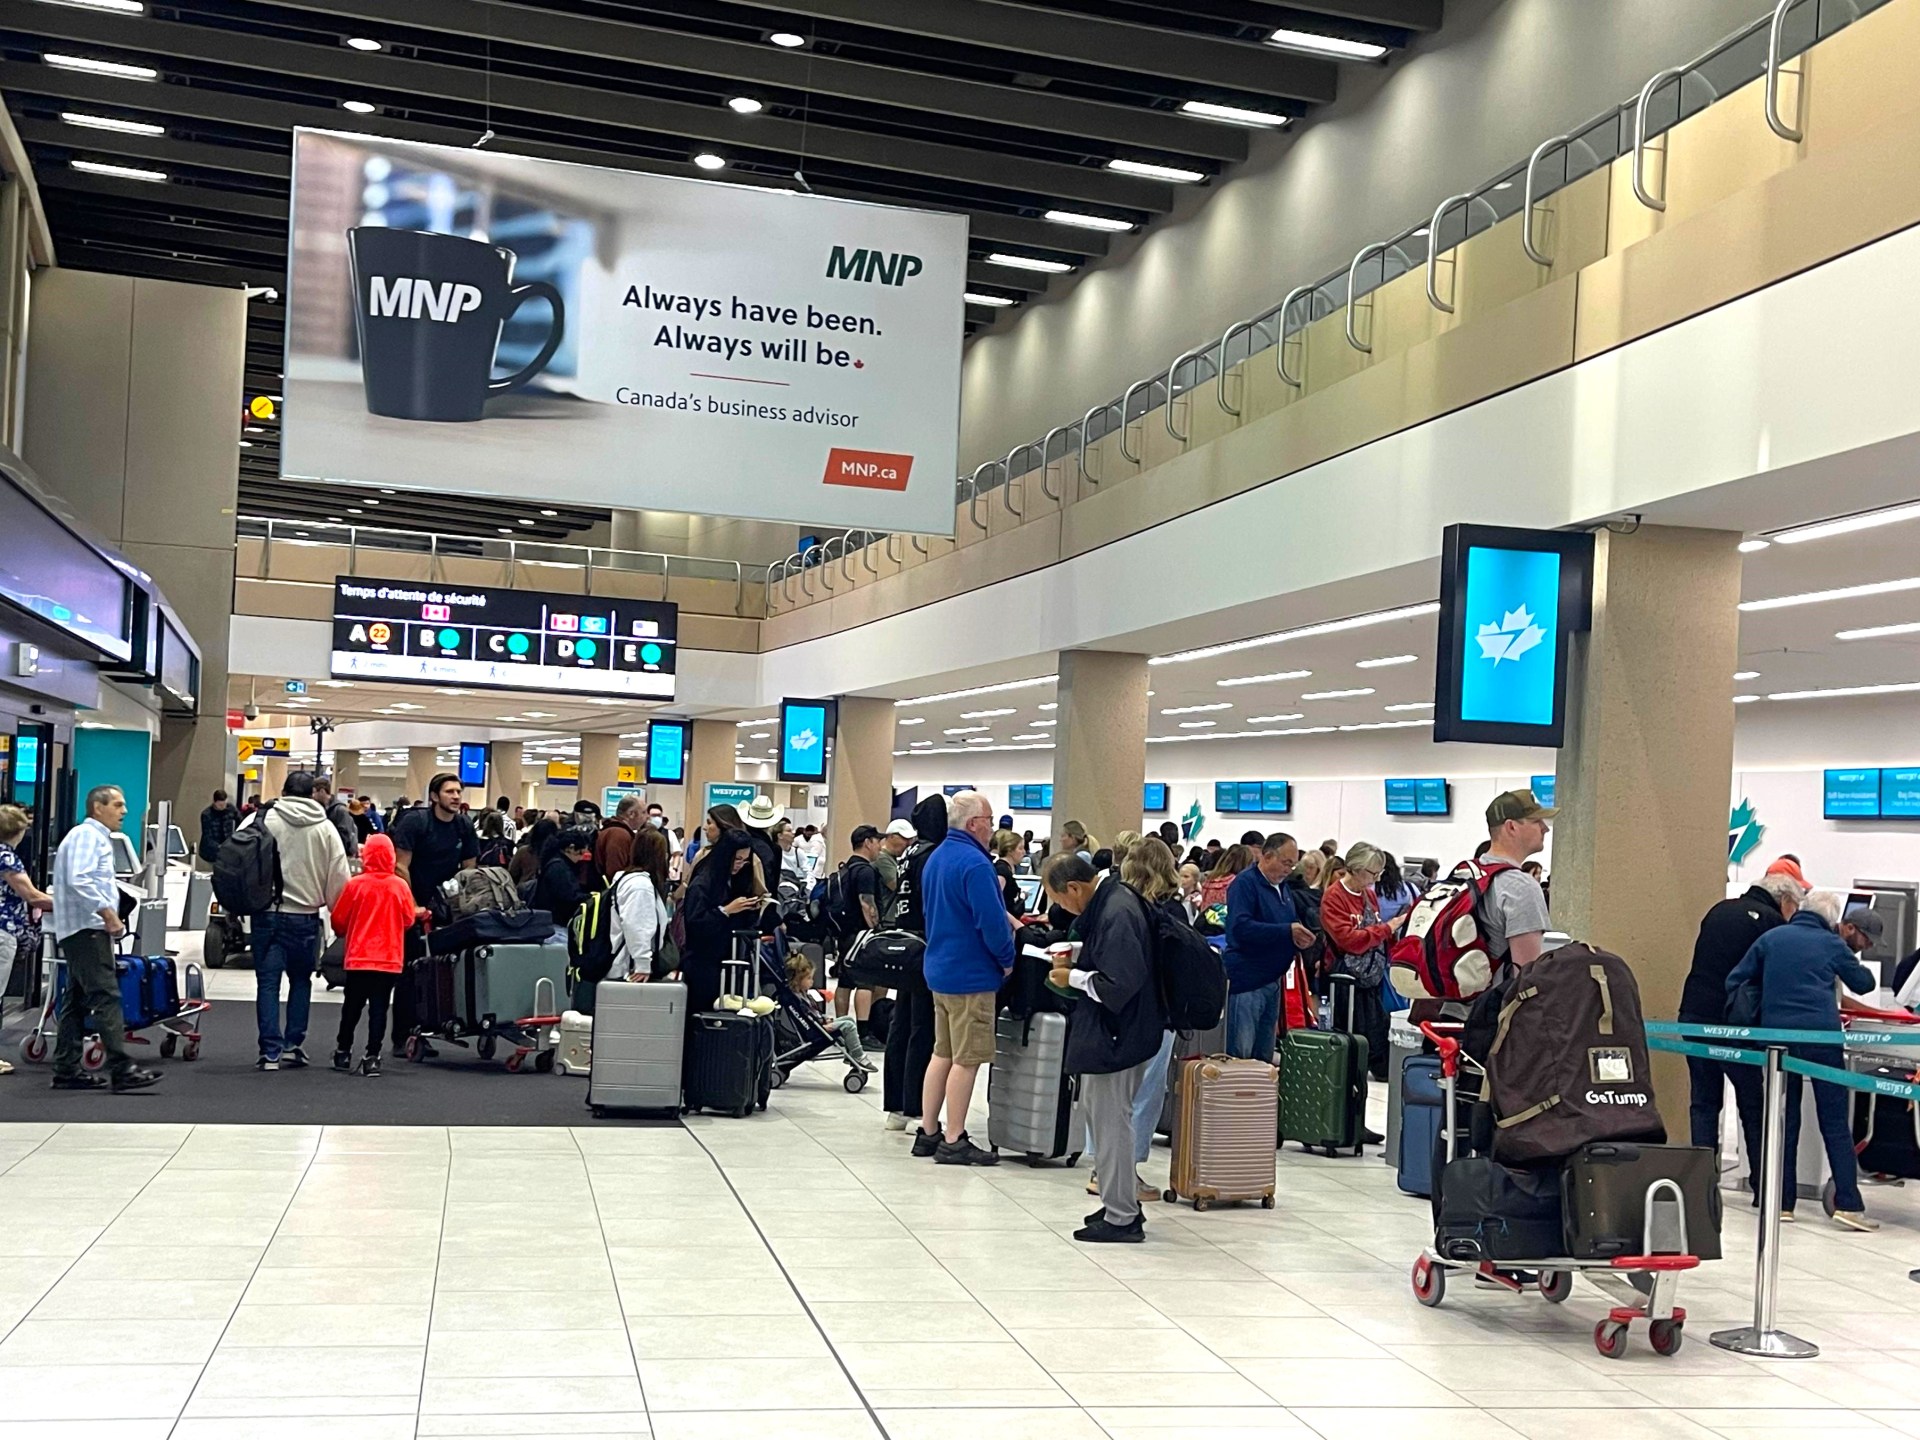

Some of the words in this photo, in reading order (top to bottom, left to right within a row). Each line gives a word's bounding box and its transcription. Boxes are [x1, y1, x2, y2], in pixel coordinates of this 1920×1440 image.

[825, 246, 923, 287] MNP
[369, 276, 482, 323] MNP
[622, 285, 722, 322] Always
[731, 296, 798, 326] have
[806, 304, 882, 336] been.
[653, 325, 753, 361] Always
[761, 338, 808, 364] will
[816, 341, 851, 368] be
[615, 387, 702, 413] Canada's
[707, 395, 788, 422] business
[791, 405, 860, 428] advisor
[840, 461, 898, 480] MNP.ca
[340, 583, 377, 600] Temps
[427, 590, 443, 604] de
[444, 591, 487, 607] sécurité
[349, 623, 368, 643] A
[373, 628, 387, 639] 22
[419, 628, 436, 647] B
[488, 634, 505, 653] C
[557, 639, 575, 657] D
[623, 644, 637, 662] E
[712, 788, 744, 797] WESTJET
[1703, 1027, 1740, 1037] WESTJET
[1844, 1034, 1882, 1043] WESTJET
[1708, 1047, 1735, 1059] WESTJET
[1875, 1080, 1905, 1095] WESTJET
[1585, 1090, 1648, 1107] GeTump
